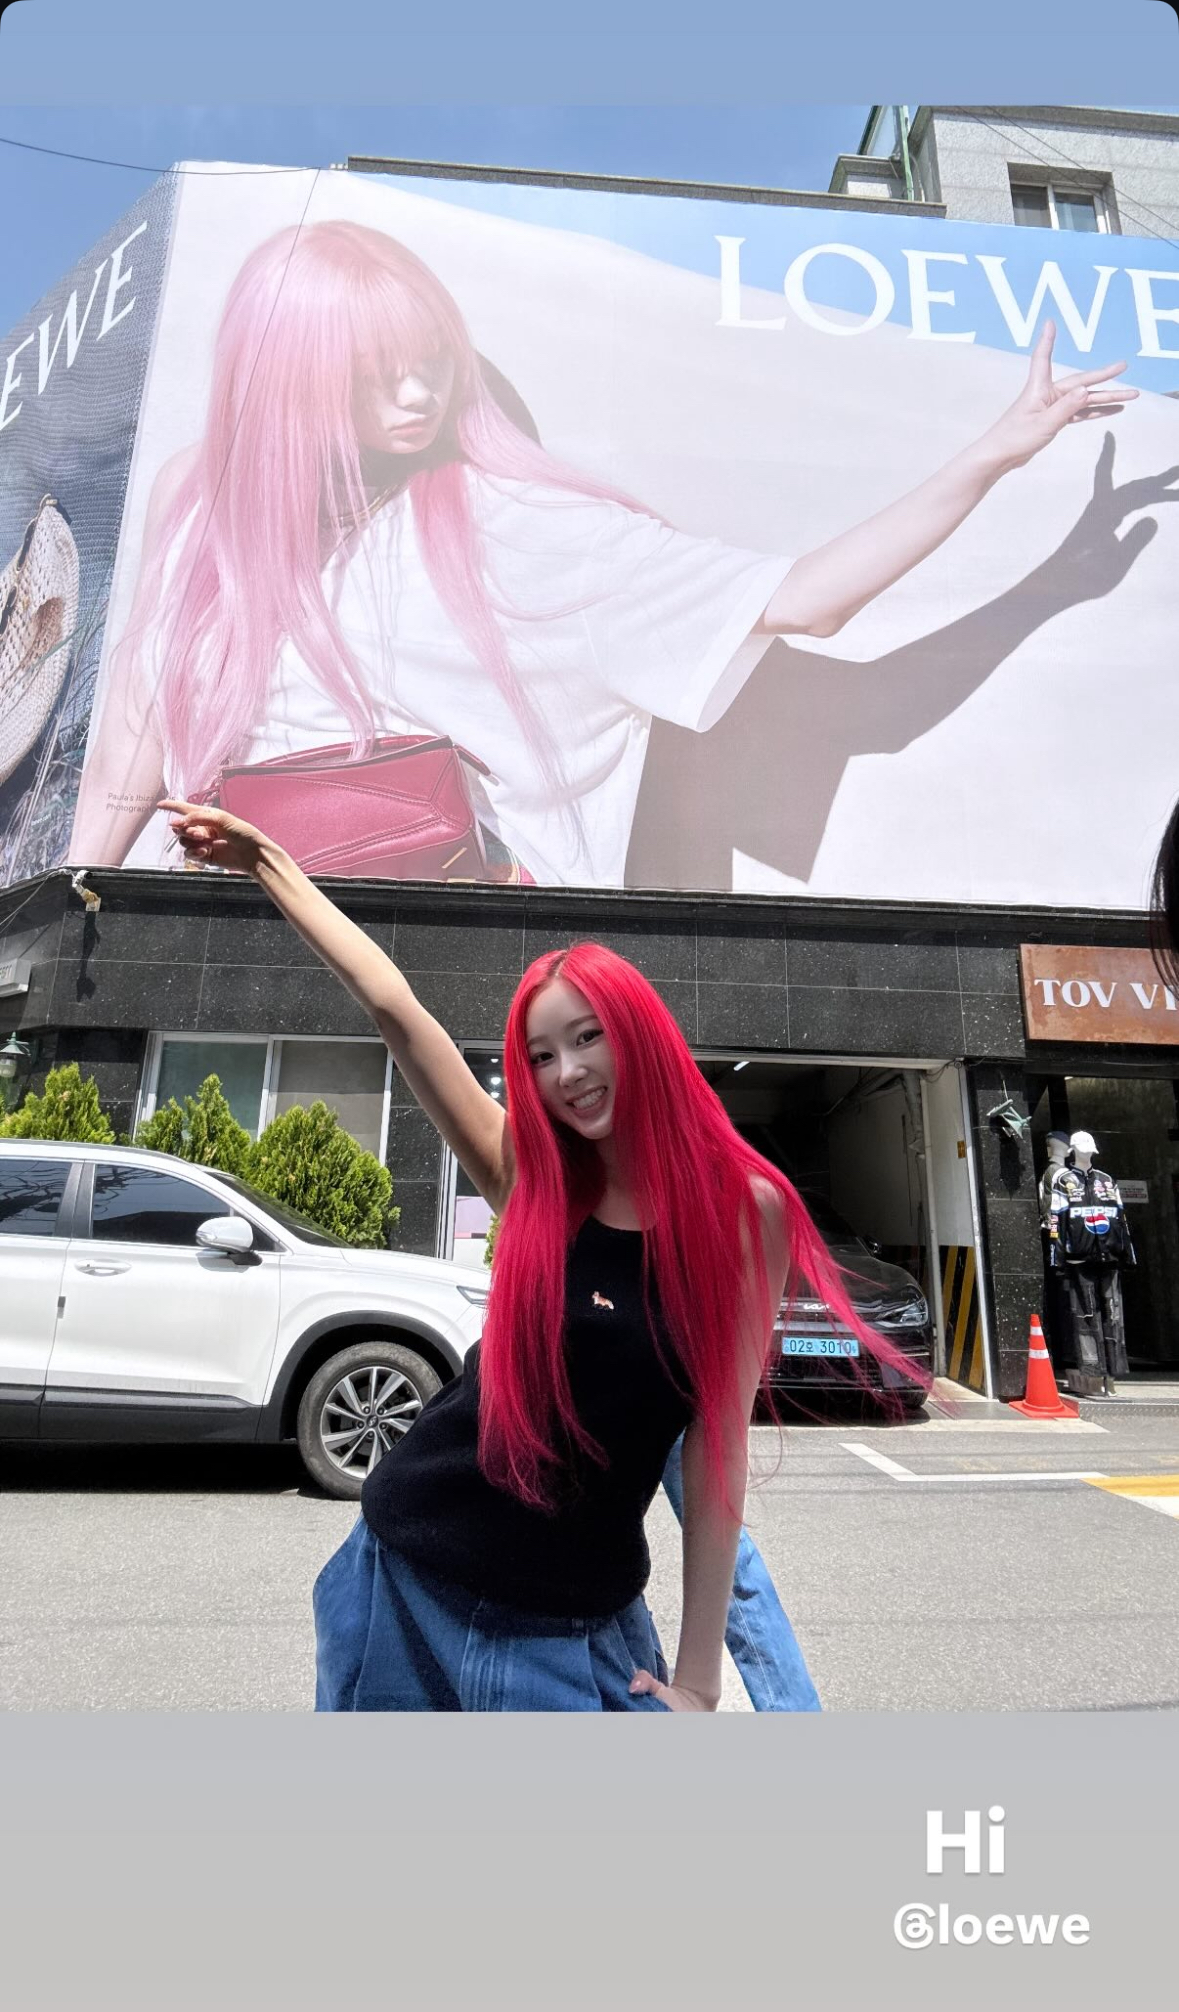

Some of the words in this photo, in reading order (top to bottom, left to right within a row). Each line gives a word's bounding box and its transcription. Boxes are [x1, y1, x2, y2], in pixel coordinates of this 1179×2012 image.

[714, 234, 1179, 358] LOEWE
[107, 792, 134, 802] Paula's
[1034, 979, 1117, 1008] TOV
[1070, 1206, 1118, 1218] PEPSI
[789, 1339, 814, 1353] 02호
[820, 1341, 852, 1355] 3010
